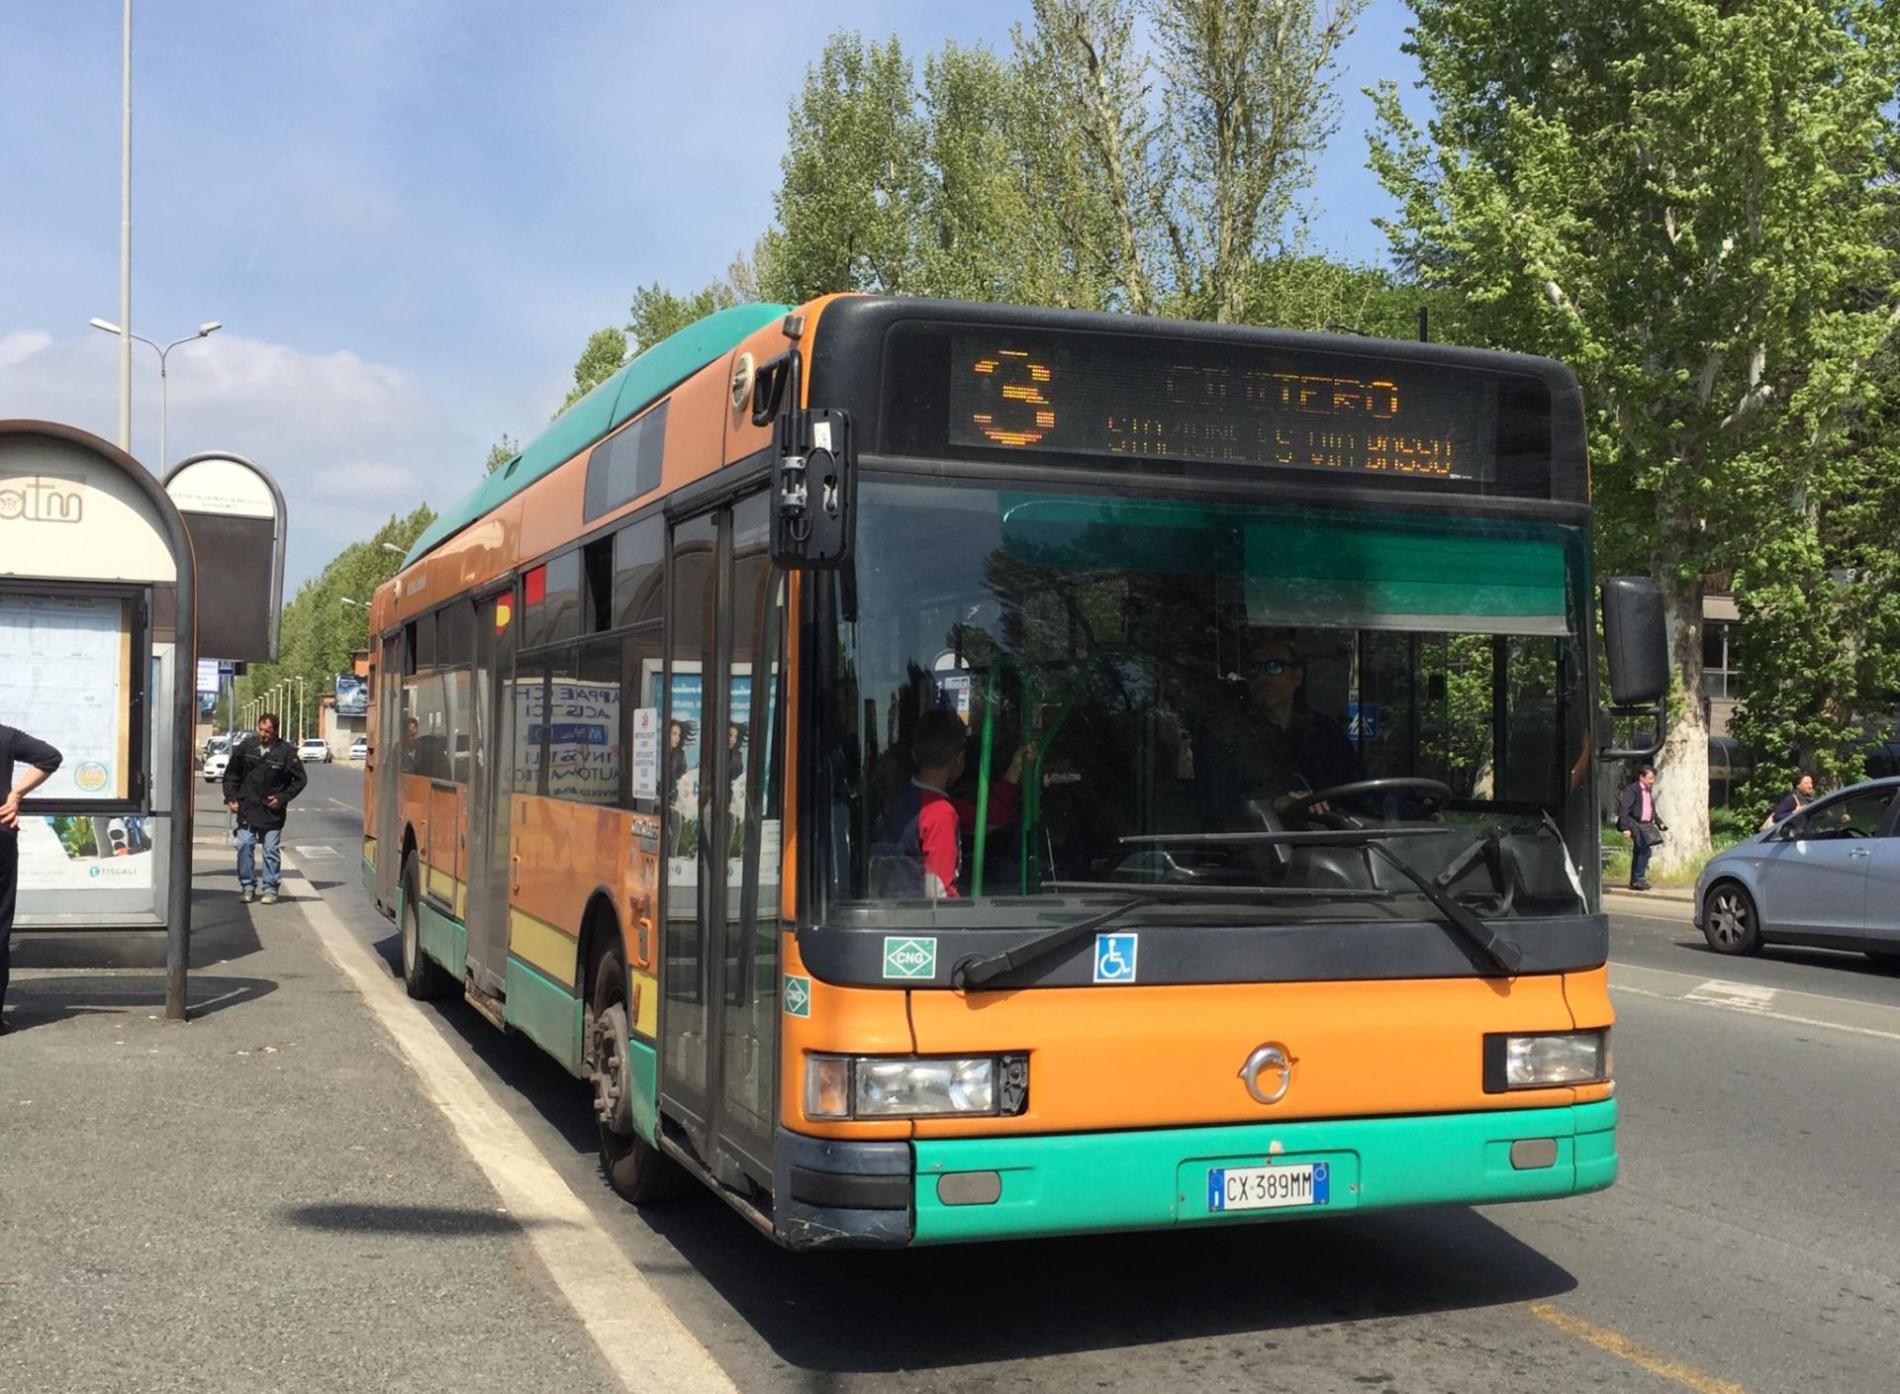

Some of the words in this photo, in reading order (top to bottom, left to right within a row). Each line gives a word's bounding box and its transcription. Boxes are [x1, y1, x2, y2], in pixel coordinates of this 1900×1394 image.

[973, 350, 1055, 446] 3
[102, 868, 137, 876] TISCALI
[896, 952, 924, 964] CNG
[784, 989, 802, 1002] CNG
